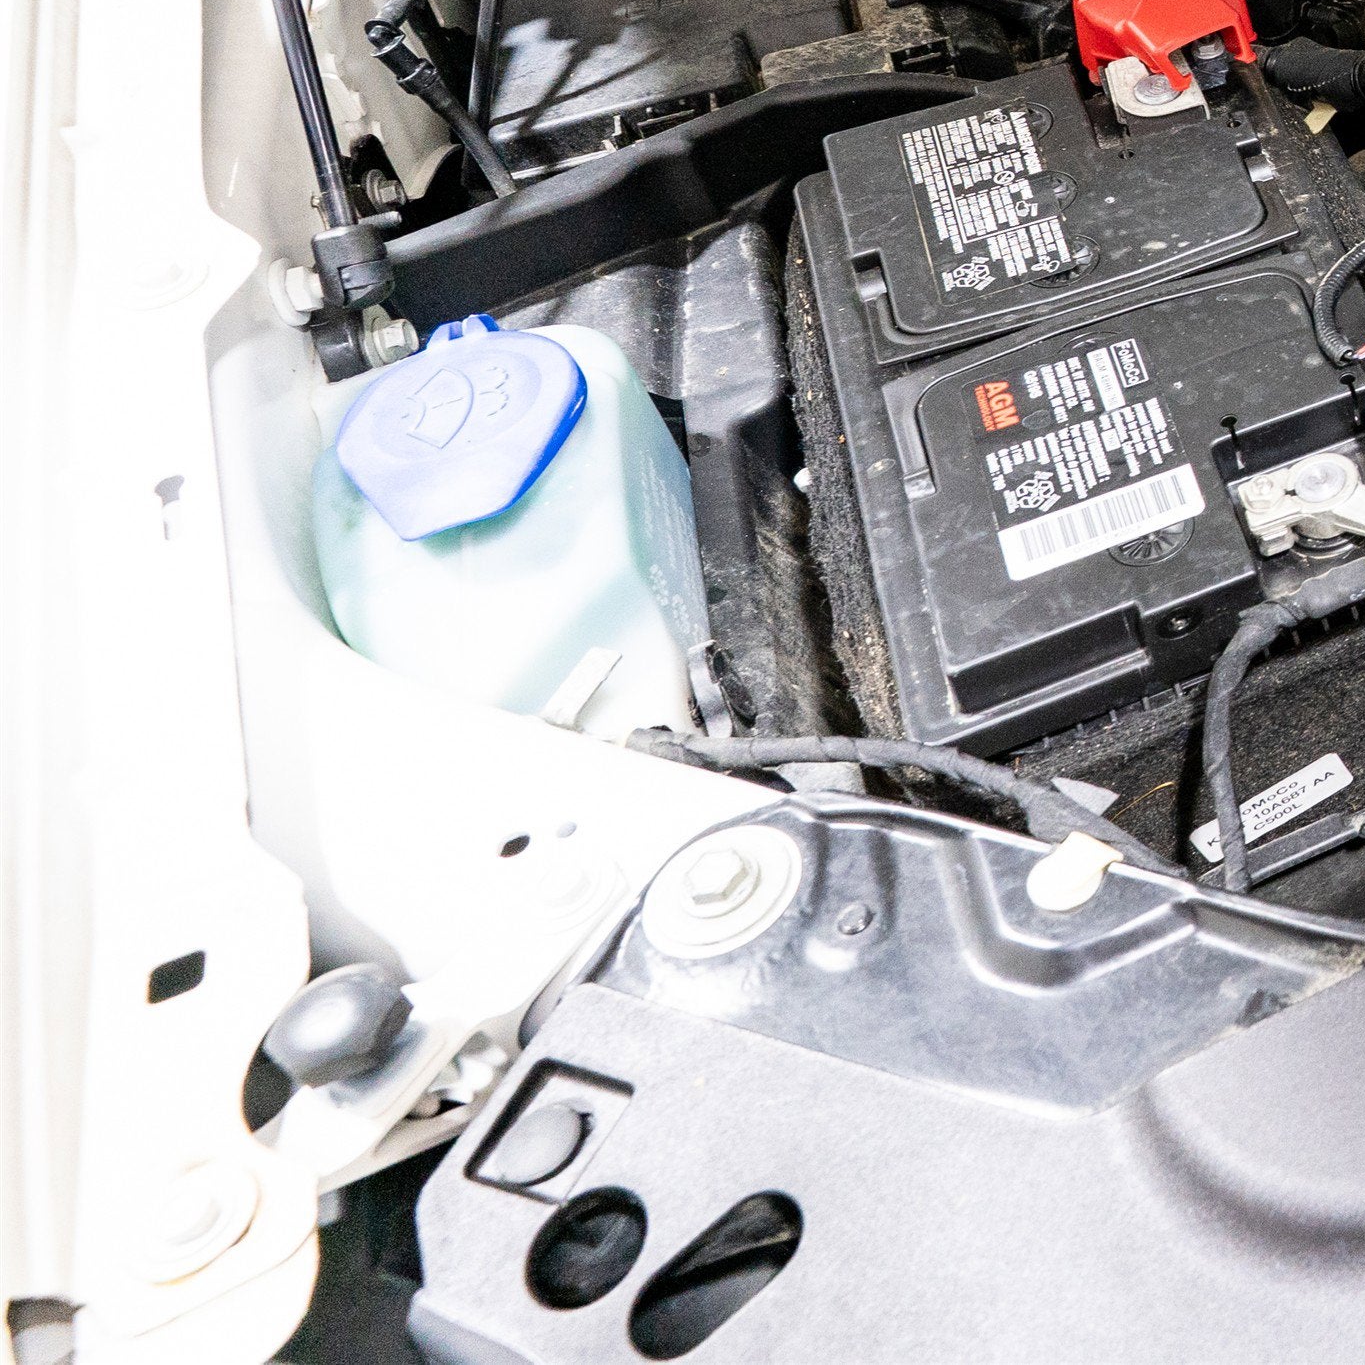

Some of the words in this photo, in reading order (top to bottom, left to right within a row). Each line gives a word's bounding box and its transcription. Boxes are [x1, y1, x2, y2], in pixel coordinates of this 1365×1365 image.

[1116, 341, 1140, 384] FoMoCo
[975, 386, 996, 432] TECHNOLOGY
[985, 381, 1019, 429] AGM
[1241, 781, 1298, 816] oMoCo
[1253, 803, 1302, 830] C500L
[1255, 786, 1307, 819] 10A687
[1313, 771, 1335, 786] AA
